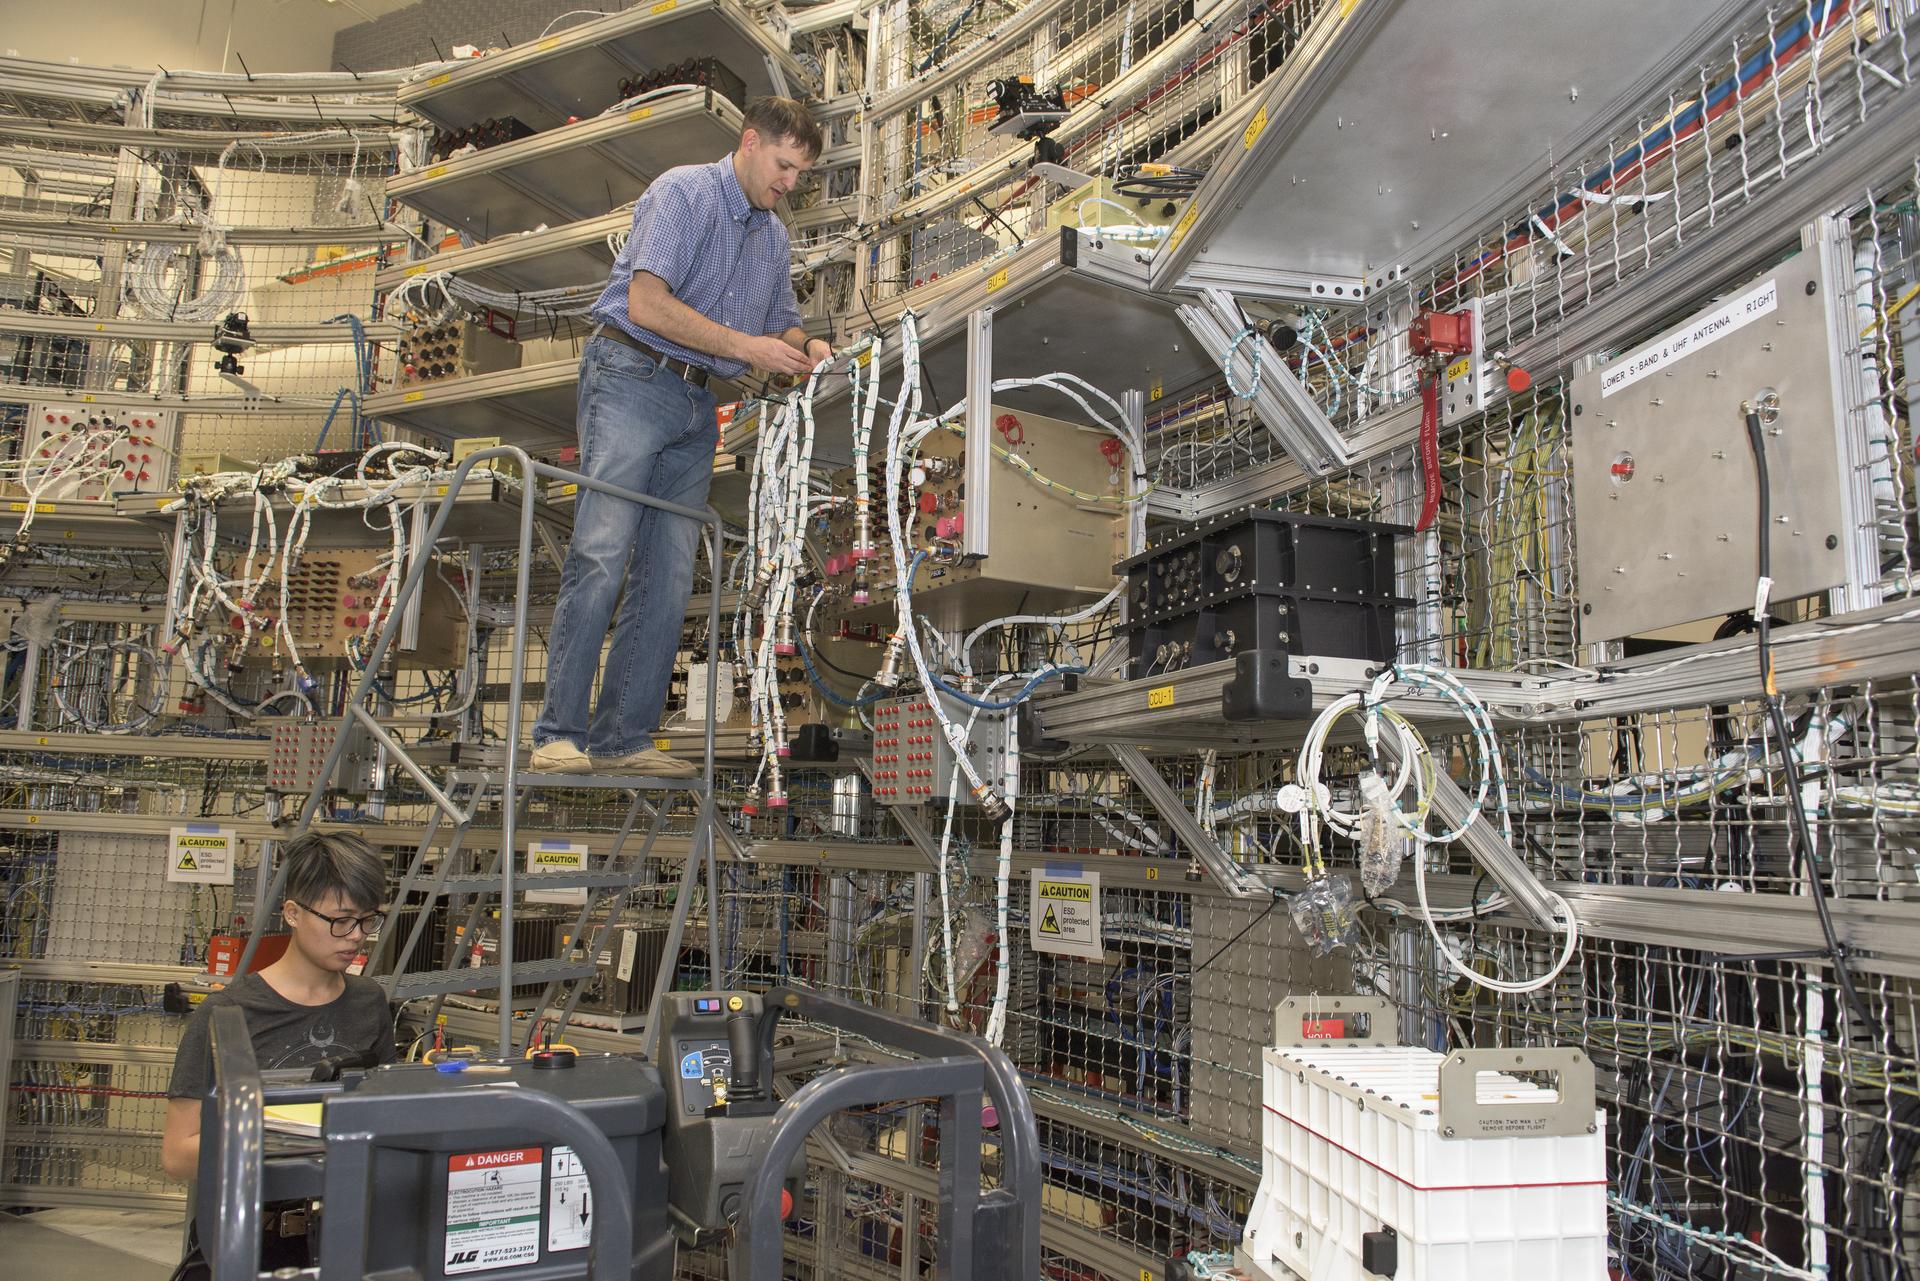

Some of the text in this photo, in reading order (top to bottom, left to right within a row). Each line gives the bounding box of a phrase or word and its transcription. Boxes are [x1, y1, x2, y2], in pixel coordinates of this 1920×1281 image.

[987, 271, 1007, 290] BU-4
[1602, 370, 1626, 390] LOWER
[1630, 353, 1659, 376] S-BAND
[1663, 348, 1669, 358] &
[1672, 337, 1689, 353] UHF
[1693, 315, 1731, 342] ANTENNA
[1746, 289, 1775, 314] RIGHT
[1448, 361, 1469, 379] S&A 2
[1153, 387, 1160, 400] G
[1424, 439, 1433, 470] BEFORE
[1429, 472, 1437, 503] REMOVE
[1149, 688, 1172, 706] CCU-1
[656, 740, 669, 749] SS-1
[188, 839, 226, 848] CAUTION
[201, 858, 225, 867] protected
[544, 855, 578, 864] CAUTION
[1149, 868, 1155, 880] D
[1049, 886, 1090, 899] CAUTION
[1063, 907, 1076, 915] ESD
[1063, 917, 1090, 927] protected
[1063, 926, 1076, 934] area
[477, 1151, 524, 1166] DANGER
[478, 1217, 512, 1228] IMPORTANT
[484, 1245, 535, 1257] 1-877-523-3374
[447, 1250, 480, 1266] JLG
